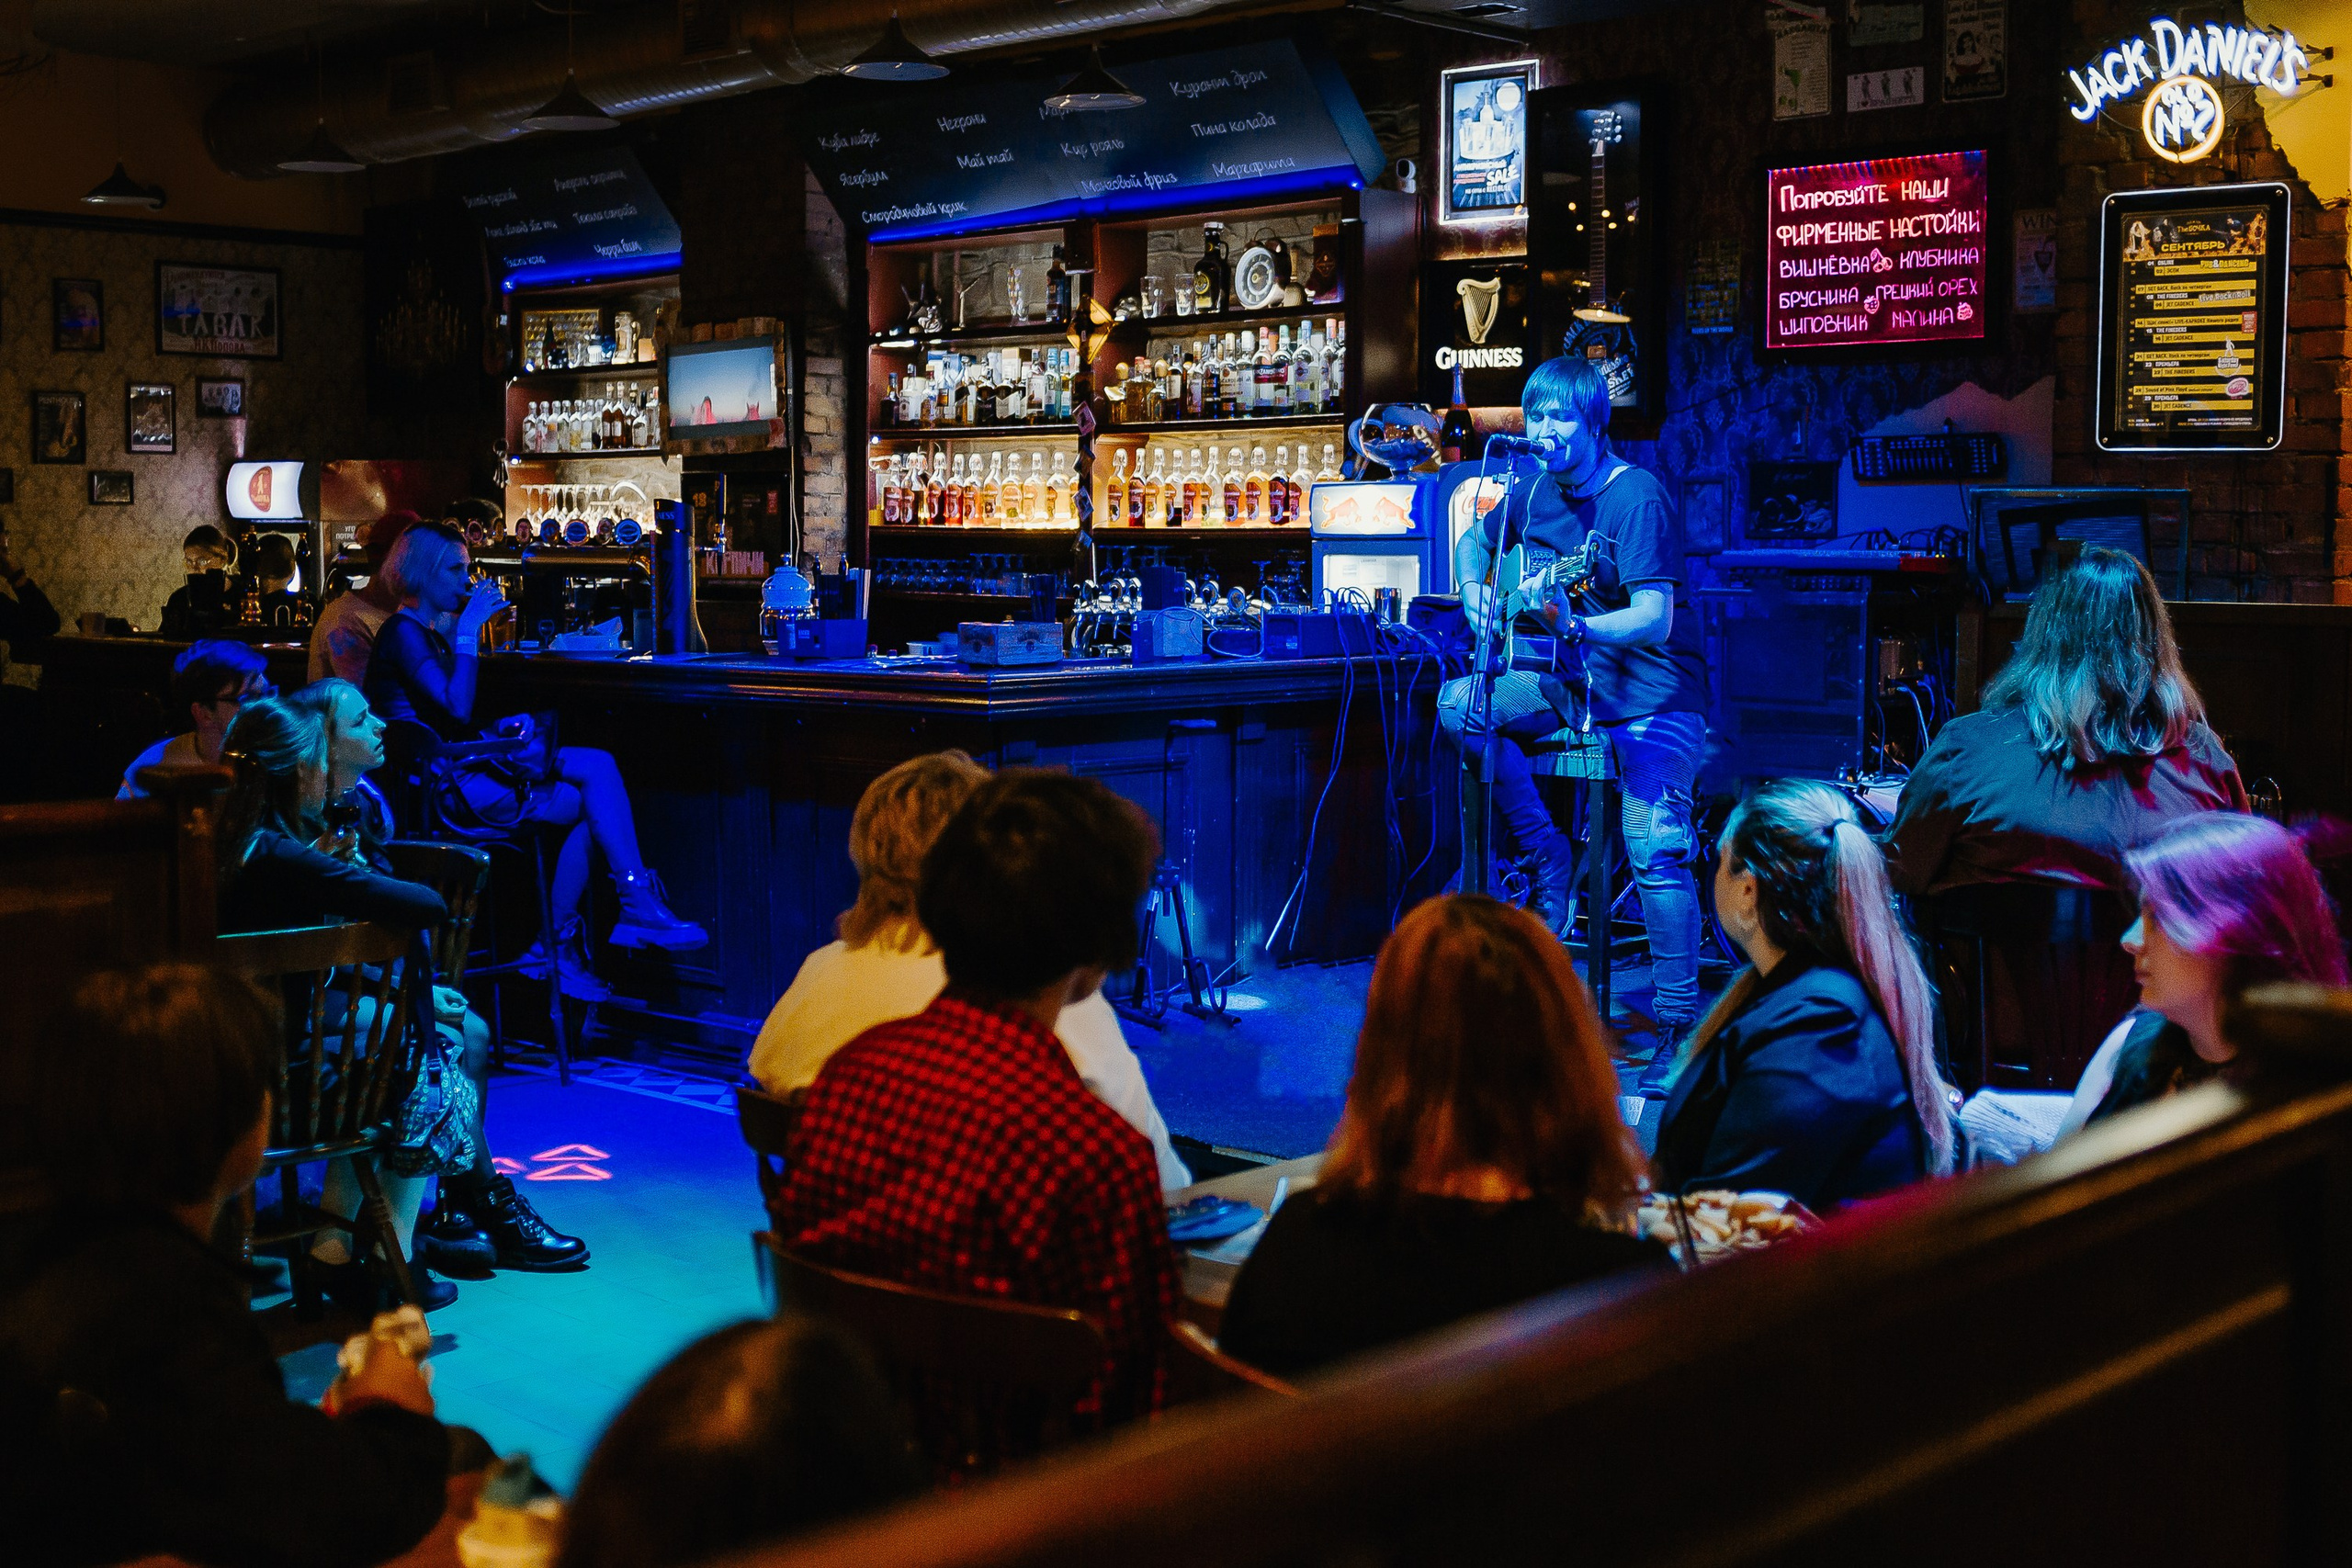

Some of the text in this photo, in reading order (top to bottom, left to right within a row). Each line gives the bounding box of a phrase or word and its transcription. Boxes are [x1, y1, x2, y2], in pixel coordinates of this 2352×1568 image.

[2067, 16, 2311, 124] JACK DANIEL'S
[1191, 111, 1277, 137] Пина колада
[1212, 156, 1296, 178] Маргарита
[1487, 164, 1521, 186] SALE
[1901, 178, 1949, 201] НАШИ
[938, 200, 968, 219] крик
[1776, 209, 1980, 246] ФИРМЕННЫЕ НАСТОЙКИ
[2161, 241, 2225, 253] СЕНТЯБРЬ
[1780, 254, 1871, 278] ВИШНЁВКА
[1900, 248, 1979, 269] КЛУБНИКА
[1939, 278, 1978, 296] ОРЕХ
[1780, 288, 1859, 309] БРУСНИКА
[1780, 315, 1869, 335] ШИПОВНИК
[1892, 308, 1954, 328] МАЛИНА
[1435, 346, 1523, 369] GUINNESS
